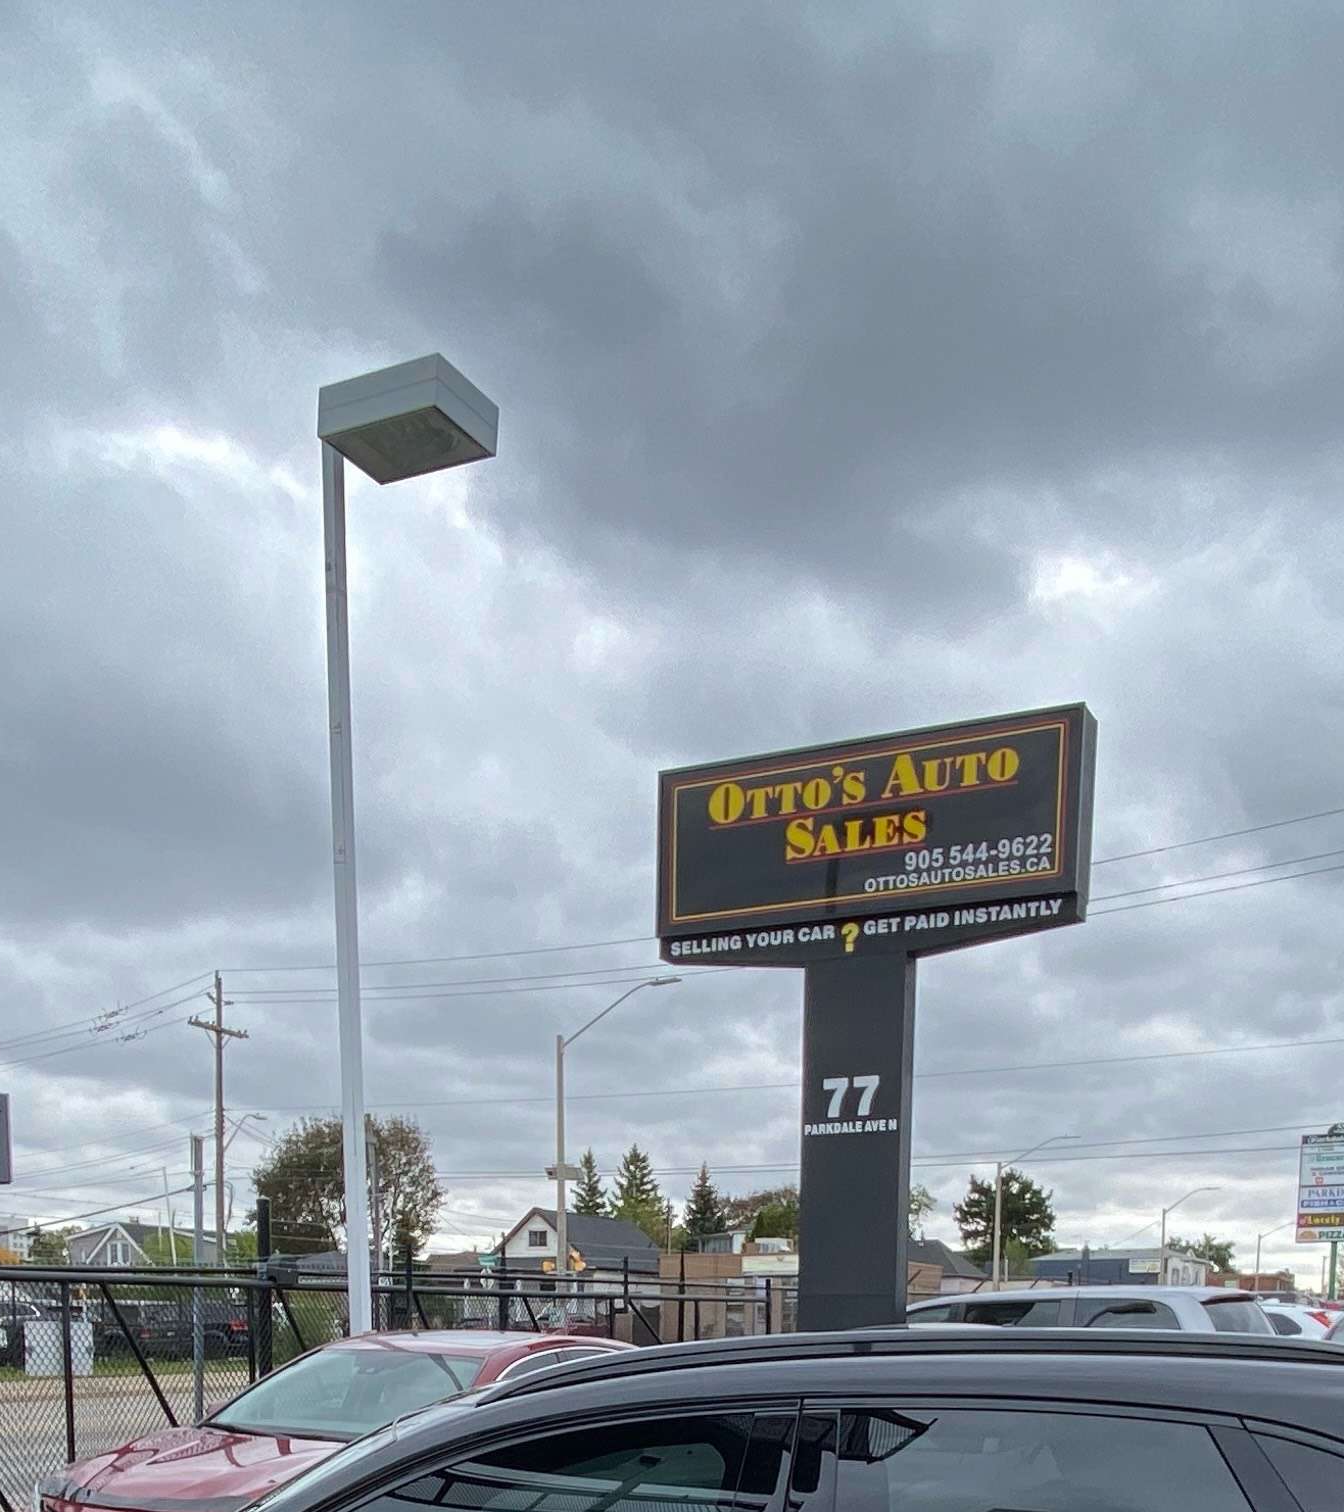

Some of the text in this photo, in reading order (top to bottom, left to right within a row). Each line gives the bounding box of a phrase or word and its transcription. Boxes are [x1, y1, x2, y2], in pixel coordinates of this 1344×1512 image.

[905, 833, 1053, 871] 905 544-9622
[864, 856, 1051, 893] OTTOSAUTOSALES.CA
[670, 935, 742, 956] SELLING
[746, 929, 795, 949] YOUR
[798, 924, 836, 942] CAR
[863, 917, 901, 936] GET
[905, 912, 950, 931] PAID
[954, 899, 1062, 927] INSTANTLY
[823, 1075, 880, 1118] 77
[804, 1118, 897, 1136] PARKDALE AVE N
